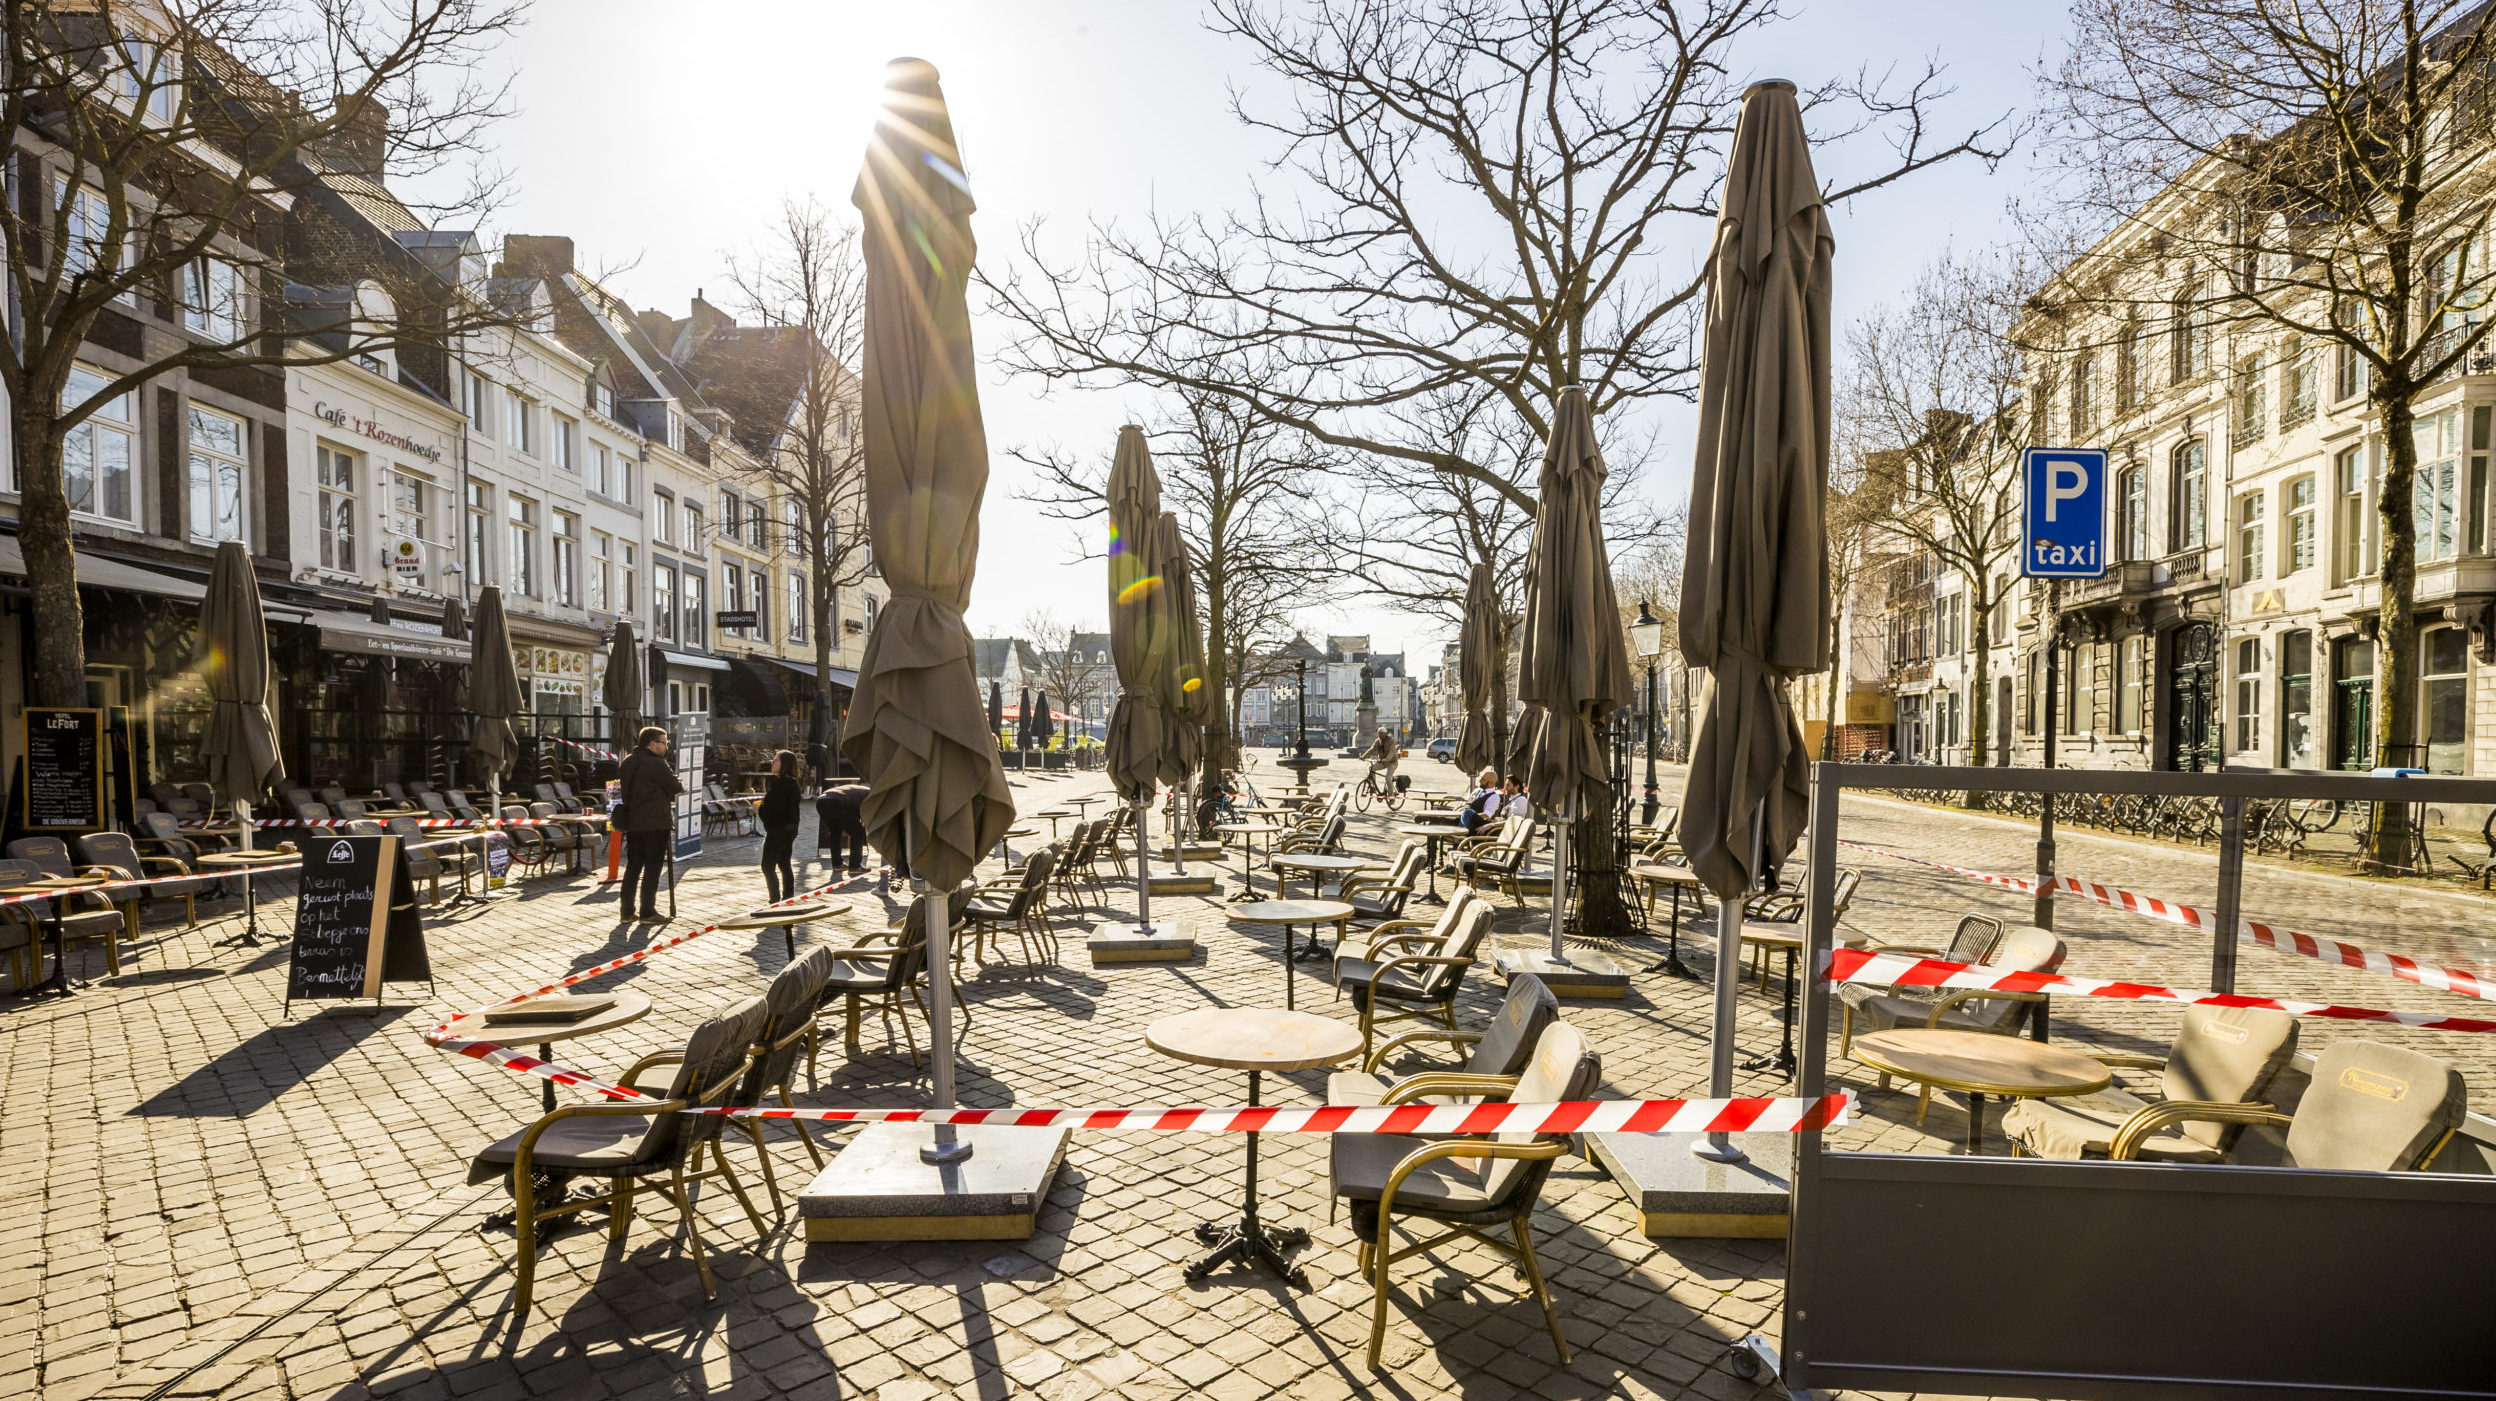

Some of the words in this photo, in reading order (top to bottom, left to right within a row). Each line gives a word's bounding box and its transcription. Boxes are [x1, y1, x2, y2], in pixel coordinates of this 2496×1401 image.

[315, 401, 346, 427] Café
[353, 416, 361, 432] 't
[364, 420, 440, 464] Rozenhoedje
[2045, 461, 2089, 522] P
[2034, 540, 2096, 566] taxi
[331, 850, 350, 860] Leffe
[305, 876, 346, 889] Neem
[303, 892, 341, 909] gerust
[344, 885, 374, 908] plaats
